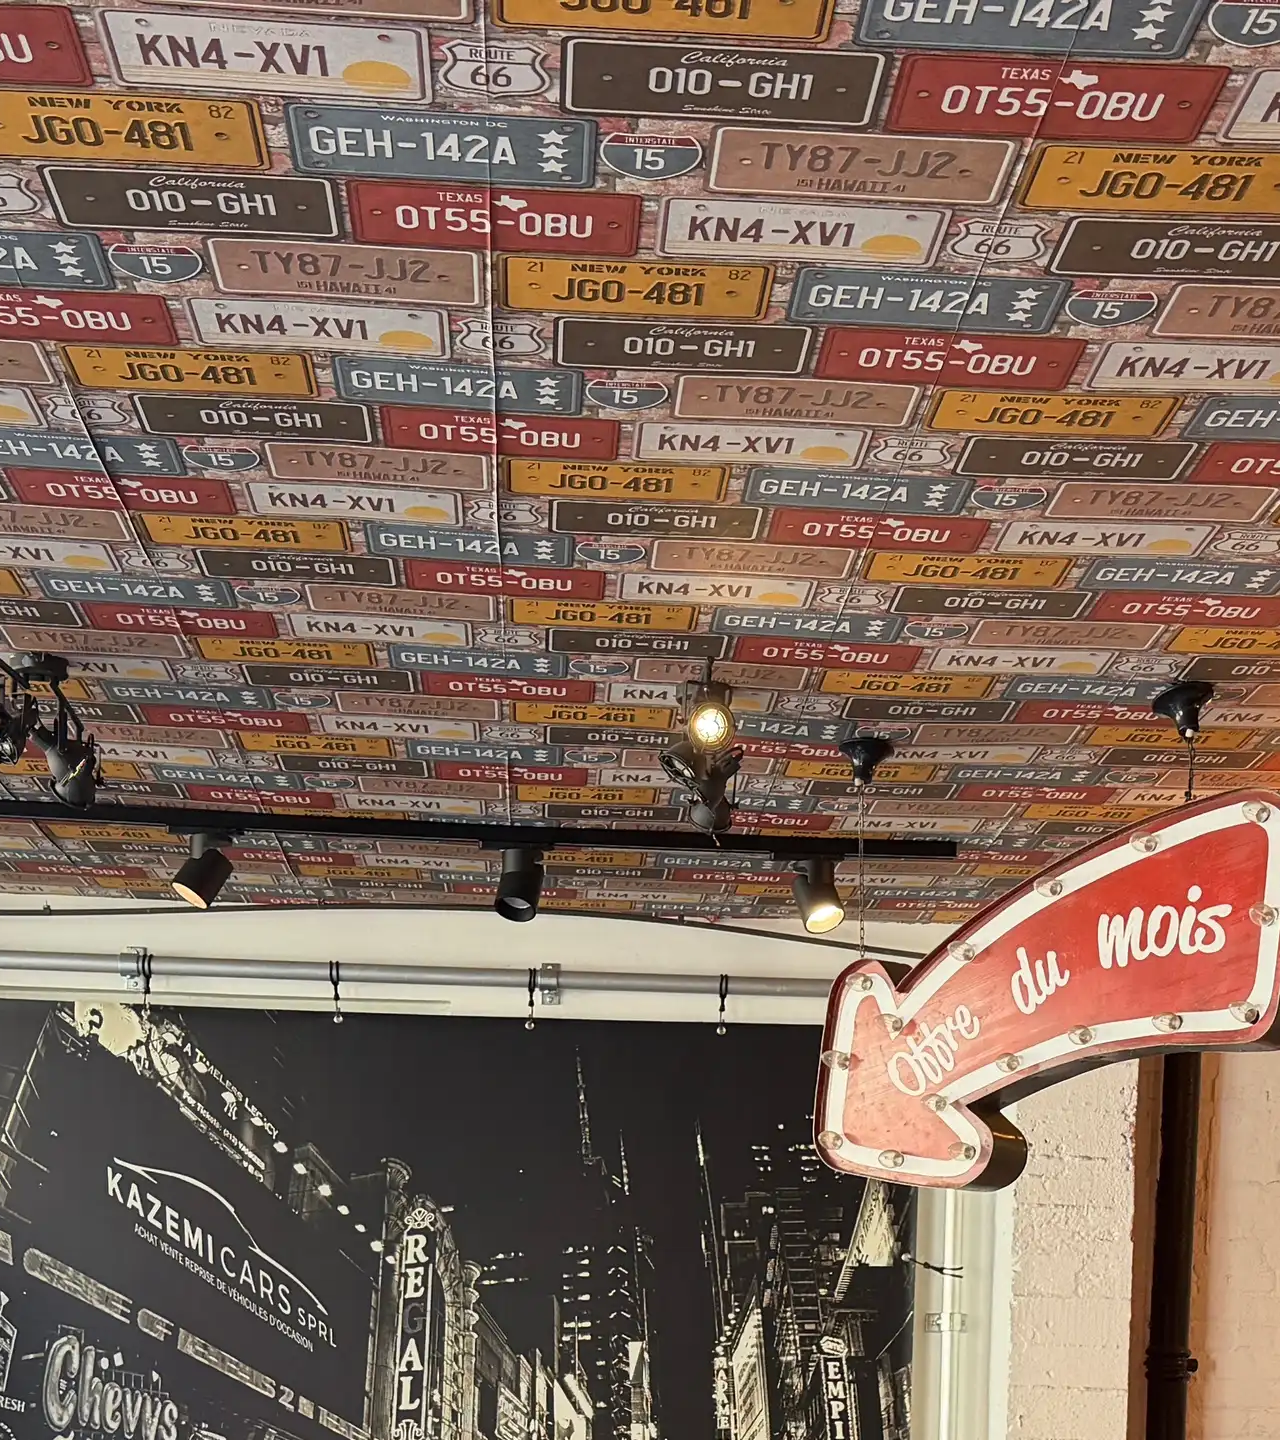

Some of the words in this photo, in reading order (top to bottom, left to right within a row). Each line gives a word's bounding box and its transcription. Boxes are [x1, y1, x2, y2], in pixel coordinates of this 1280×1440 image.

[467, 47, 517, 60] ROUTE
[680, 49, 788, 69] California
[470, 62, 511, 87] 66
[999, 66, 1052, 80] TEXAS
[25, 96, 93, 109] NEW
[103, 99, 184, 113] YORK
[206, 103, 234, 117] 82
[307, 126, 517, 164] GEH-142A
[632, 148, 666, 170] 15
[756, 142, 960, 179] TY87-JJ2
[1111, 151, 1178, 164] NEW
[1186, 154, 1266, 168] YORK
[147, 175, 246, 191] California
[816, 178, 891, 193] HAWAII
[437, 192, 482, 203] TEXAS
[978, 224, 1025, 234] ROUTE
[972, 236, 1015, 255] 66
[250, 251, 433, 282] TY87-JJ2
[806, 284, 996, 314] GEH-142A
[349, 372, 518, 398] GEH-142A
[886, 1004, 980, 1096] Offre
[1011, 947, 1070, 1015] du
[1097, 885, 1232, 968] mois
[107, 1166, 214, 1264] KAZEMI
[220, 1246, 291, 1315] CARS
[298, 1307, 337, 1348] SPRL
[134, 1223, 158, 1246] ACHAT
[159, 1238, 184, 1265] VENTE
[184, 1257, 216, 1286] REPRISE
[216, 1279, 228, 1294] DE
[228, 1285, 269, 1322] VÉHICULES
[269, 1314, 314, 1352] D'OCCASION
[399, 1233, 429, 1411] REGAL
